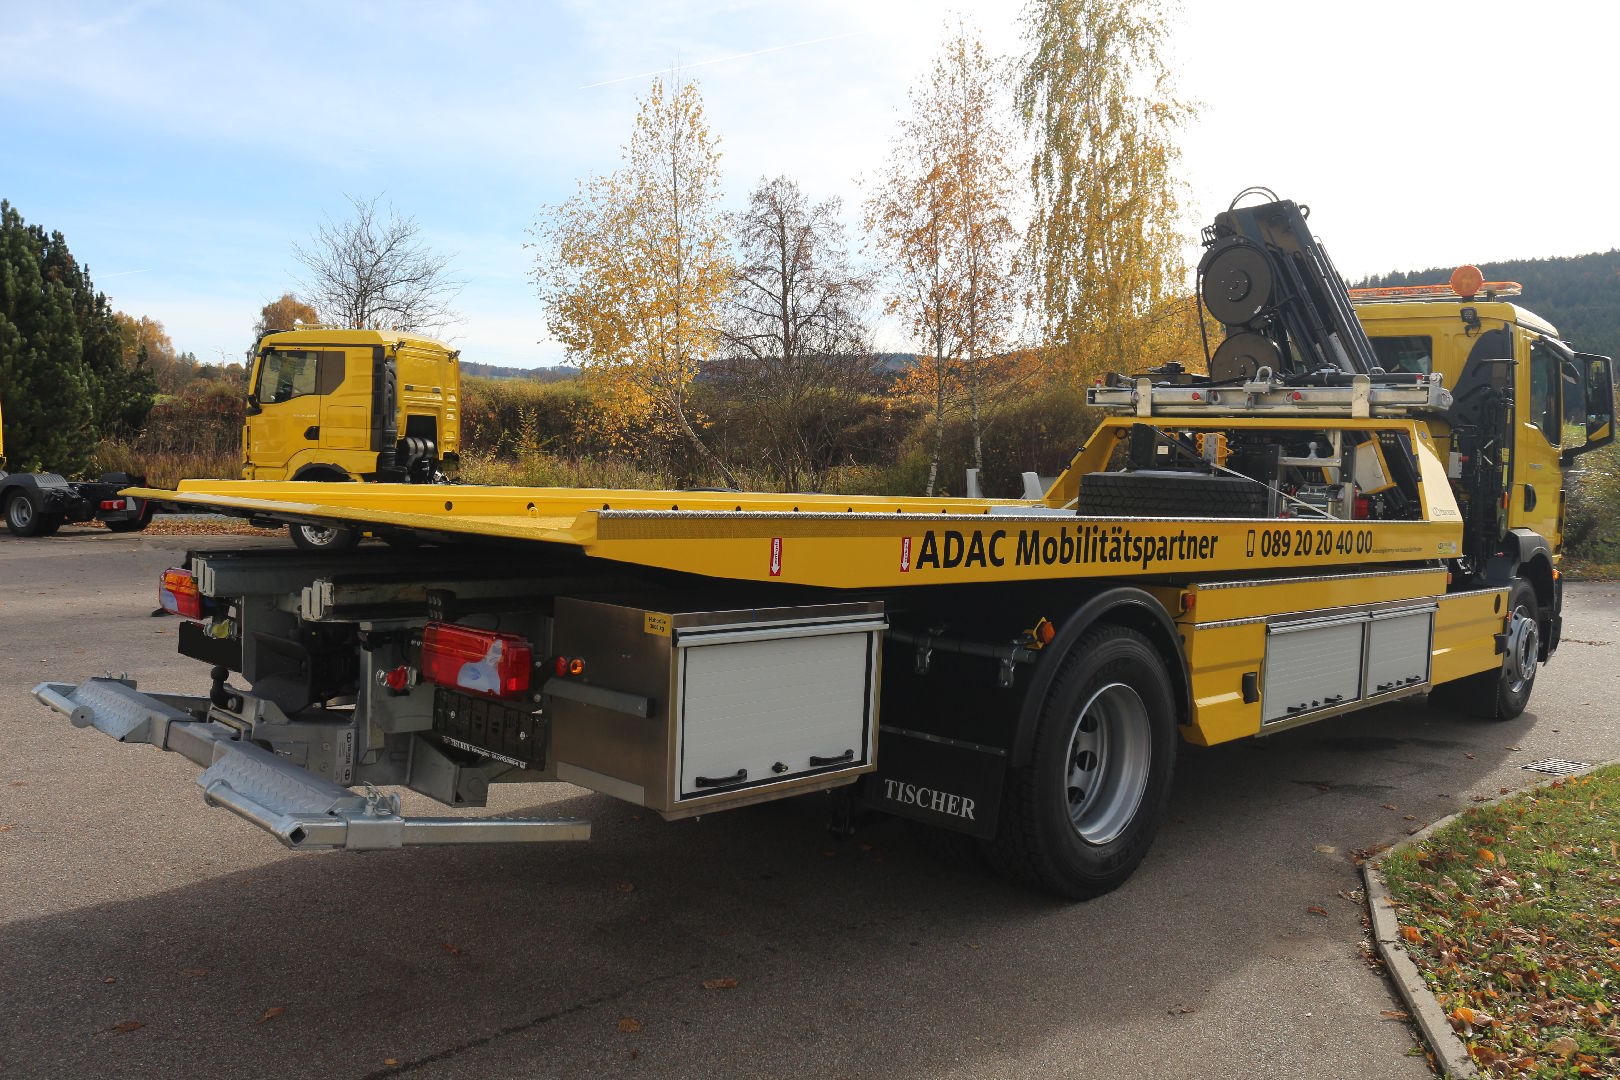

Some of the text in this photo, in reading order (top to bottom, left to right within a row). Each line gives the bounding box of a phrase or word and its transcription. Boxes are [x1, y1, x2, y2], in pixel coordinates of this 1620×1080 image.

[916, 530, 1006, 569] ADAC
[1015, 525, 1218, 570] Mobilitätspartner
[1261, 529, 1291, 557] 089
[1294, 530, 1312, 556] 20
[1315, 530, 1333, 555] 20
[1336, 530, 1353, 554] 40
[1356, 530, 1373, 554] 00
[884, 779, 975, 821] TISCHER
